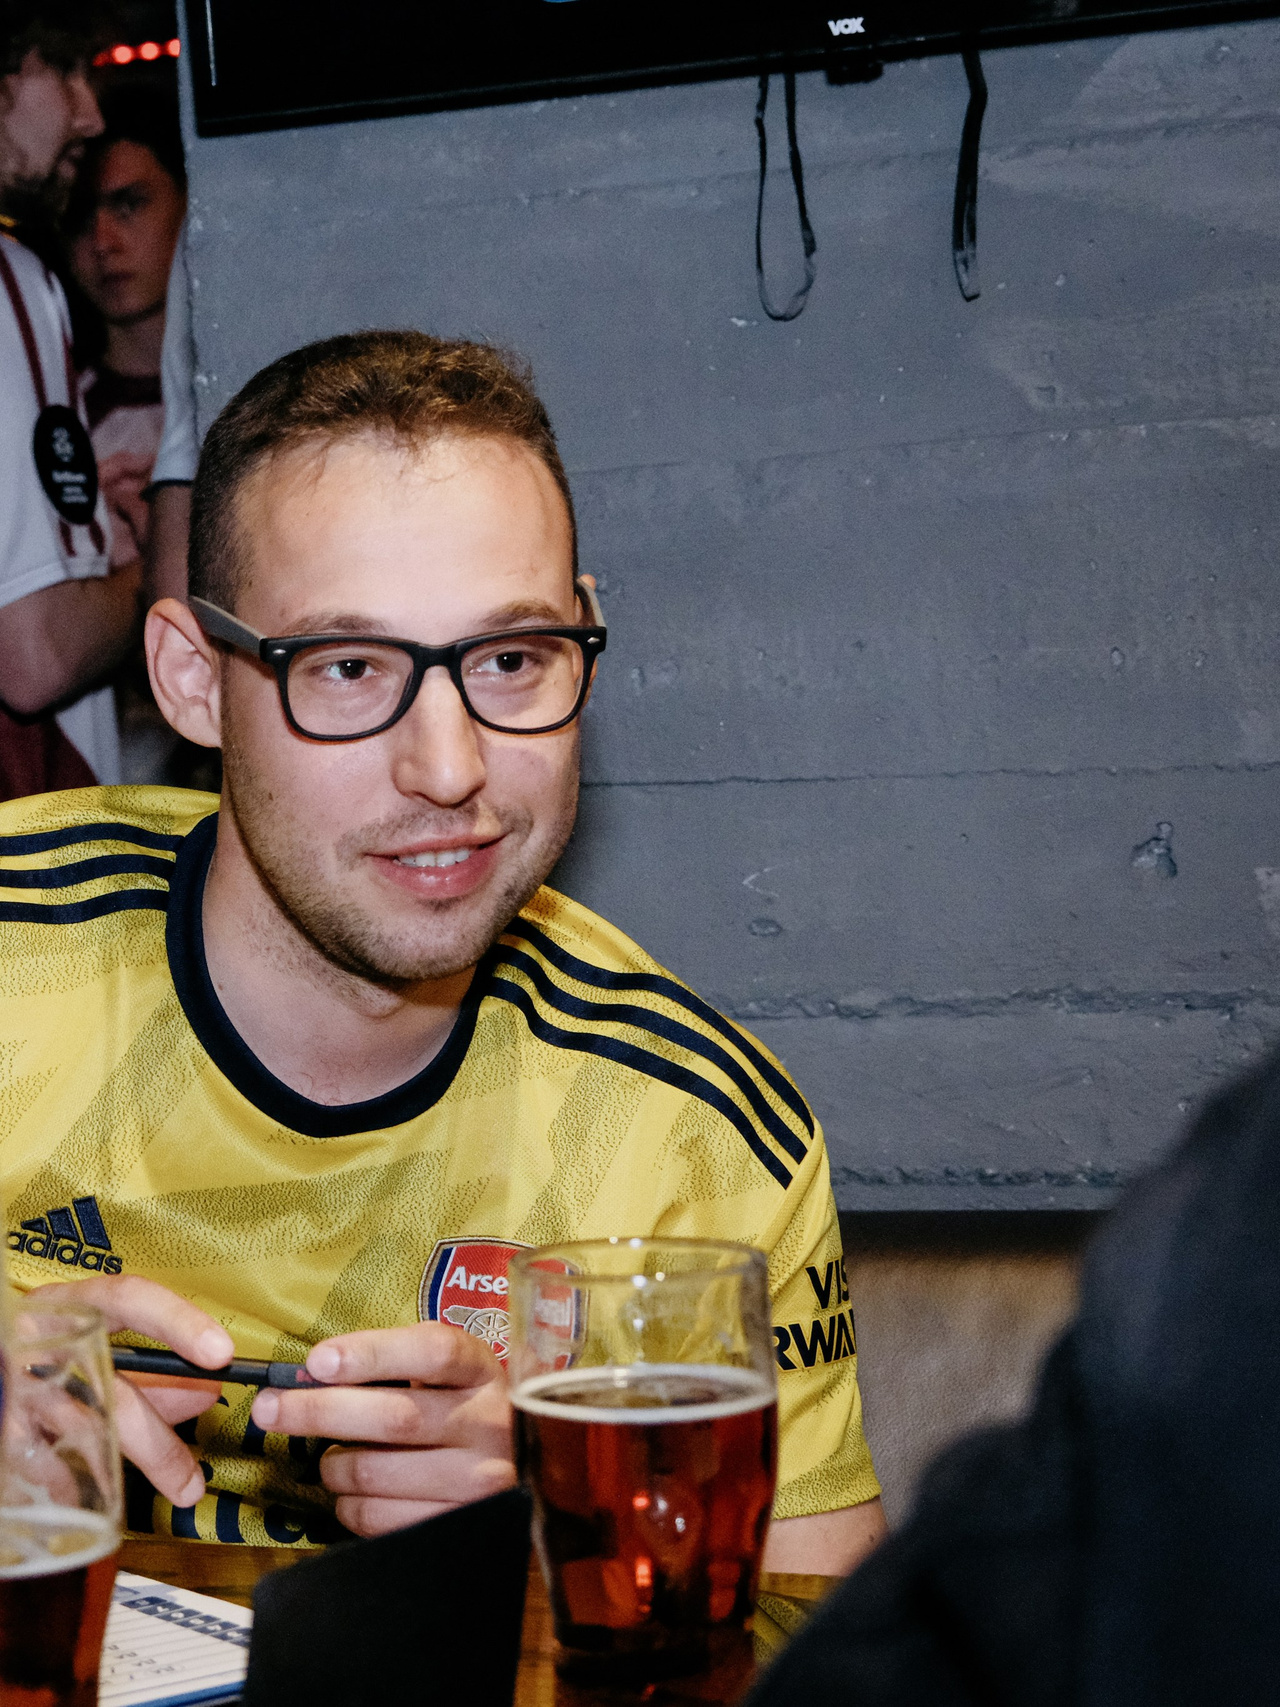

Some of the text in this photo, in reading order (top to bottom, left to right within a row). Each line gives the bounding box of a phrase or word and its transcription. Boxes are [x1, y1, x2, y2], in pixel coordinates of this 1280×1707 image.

[827, 16, 866, 36] VOX
[7, 1231, 123, 1275] adidas
[771, 1309, 858, 1371] RWA
